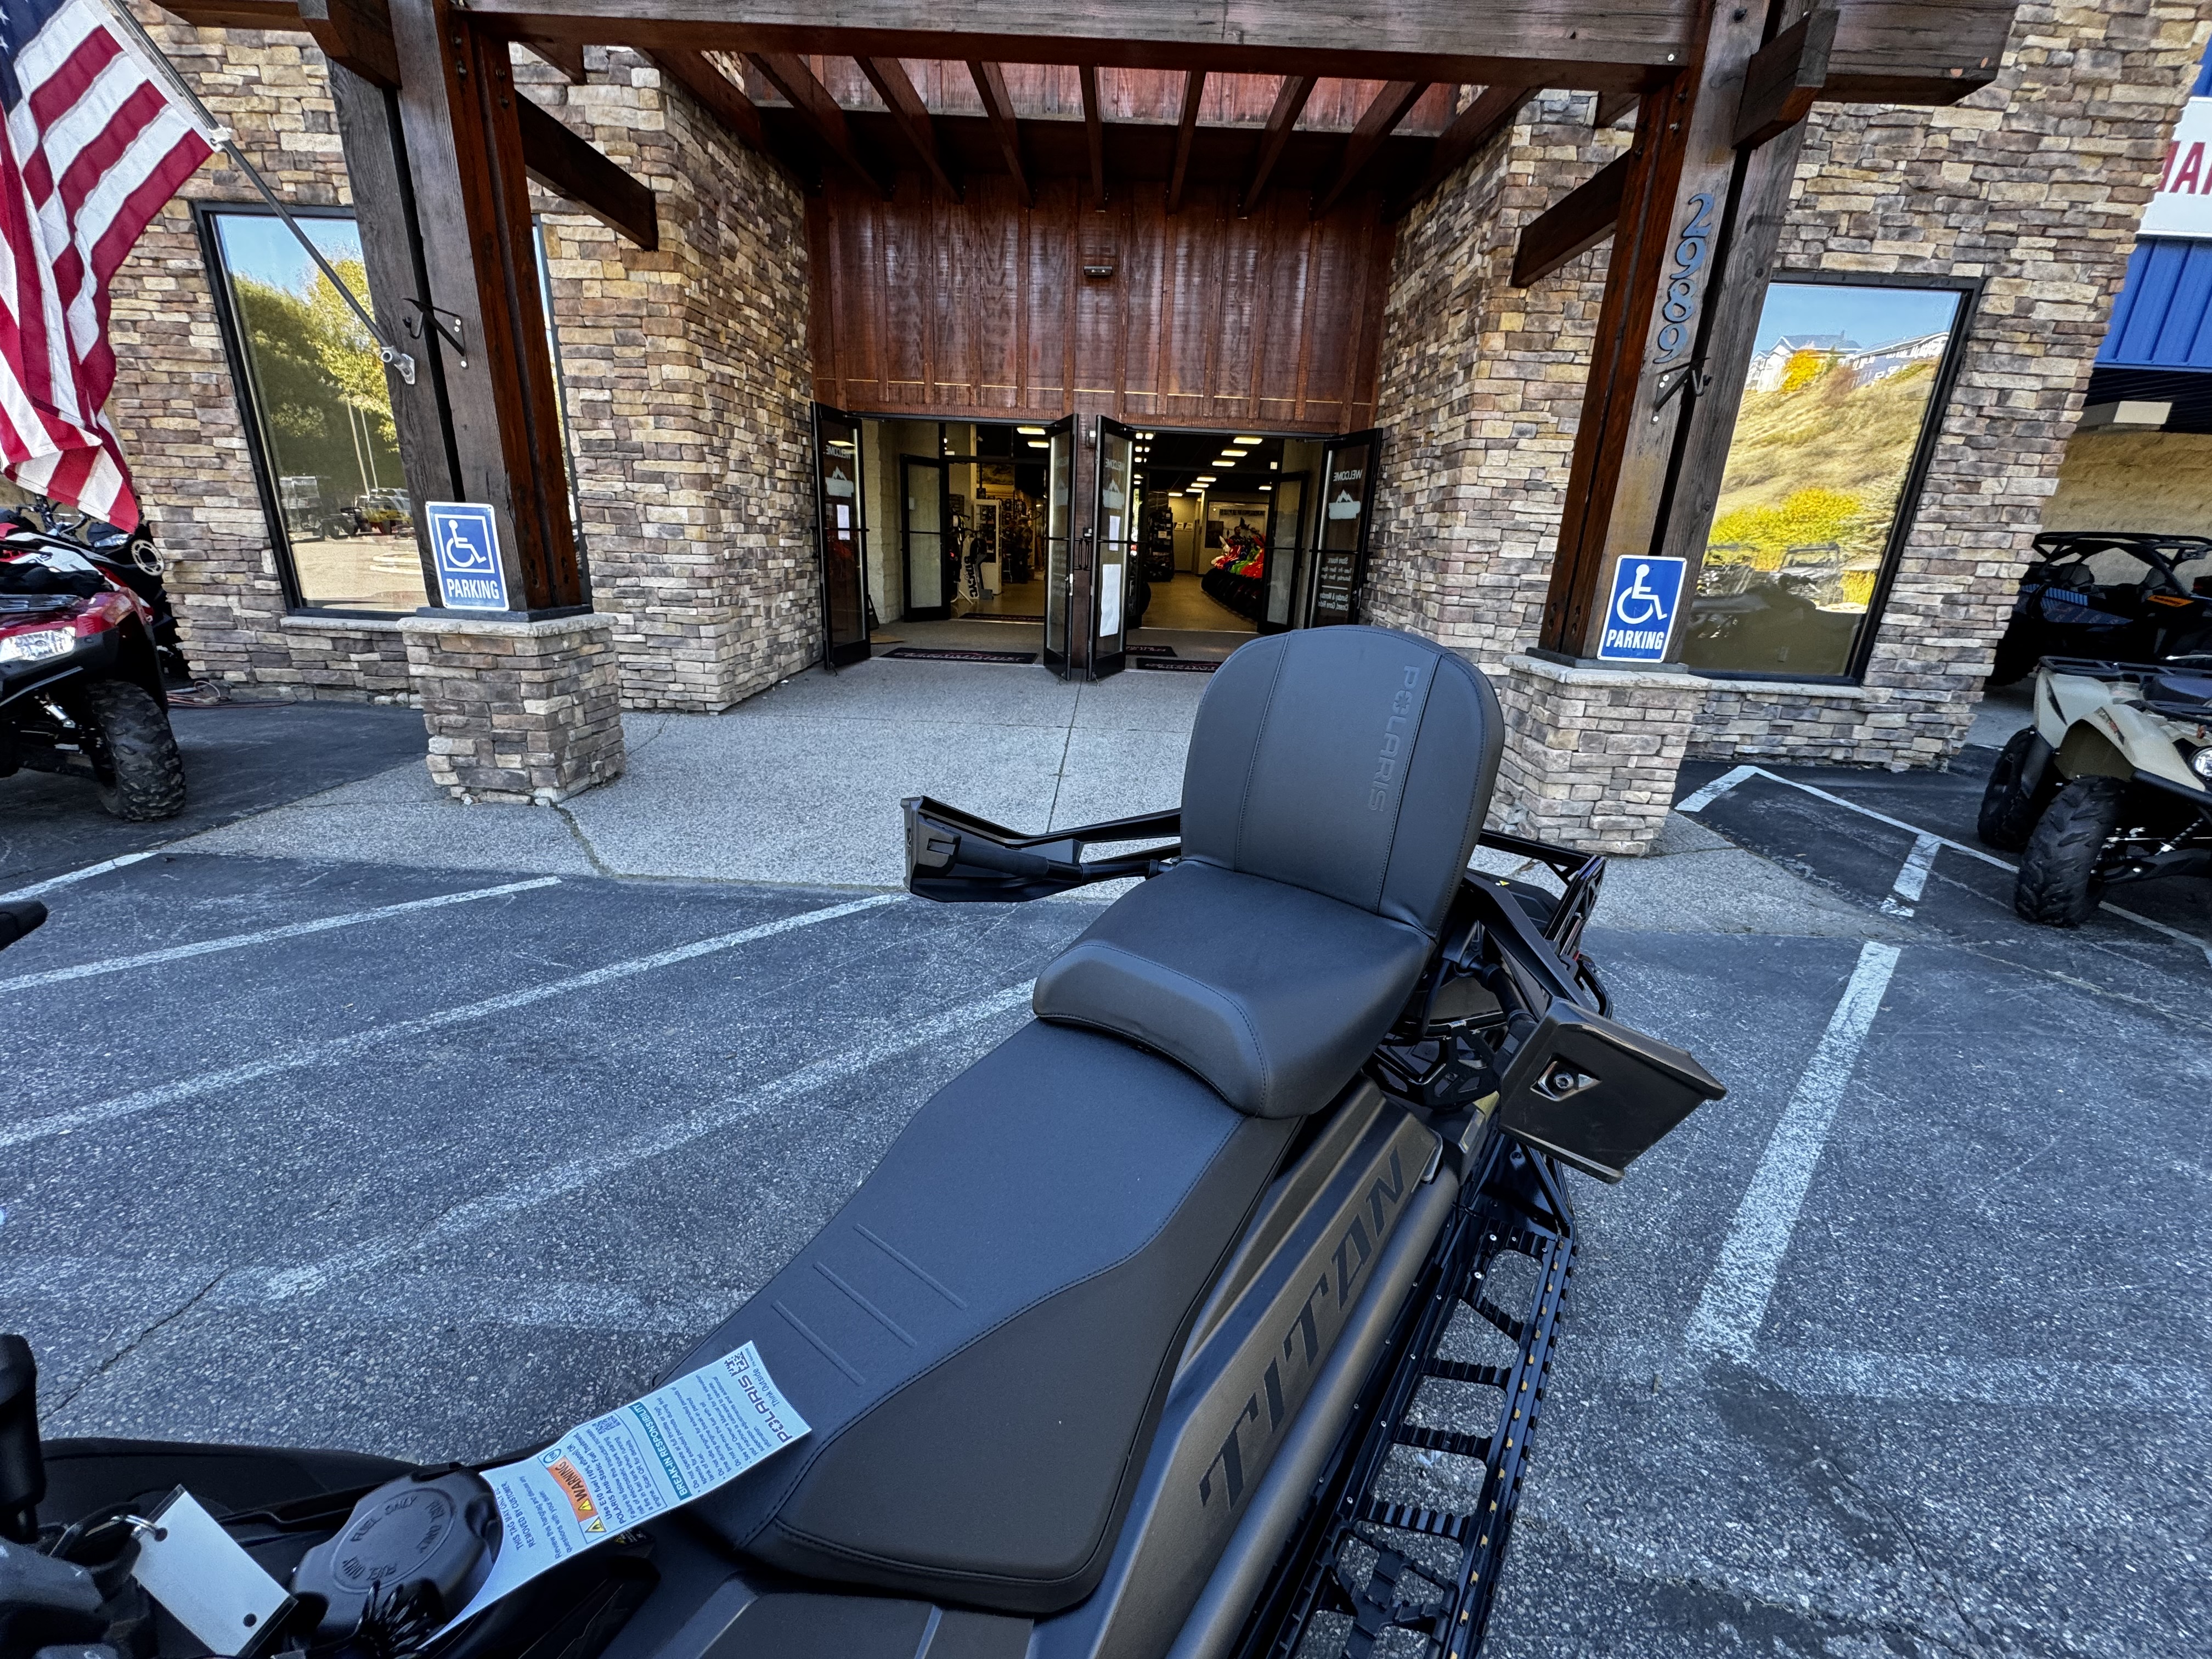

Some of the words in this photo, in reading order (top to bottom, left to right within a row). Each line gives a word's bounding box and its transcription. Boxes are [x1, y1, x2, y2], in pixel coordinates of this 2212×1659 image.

[1652, 193, 1714, 364] 2989
[446, 578, 500, 599] PARKING
[1606, 629, 1664, 650] PARKING
[1368, 665, 1421, 812] POLARIS
[1199, 1146, 1404, 1512] TITAN
[751, 1368, 770, 1392] Outside
[765, 1390, 780, 1407] Think
[737, 1374, 793, 1443] POLARIS
[632, 1403, 668, 1458] RESPONSIBILITY
[586, 1451, 599, 1464] Fuel
[712, 1458, 720, 1468] not
[729, 1450, 737, 1460] not
[733, 1458, 741, 1466] Do
[584, 1464, 597, 1480] (10%
[594, 1462, 613, 1494] Anti-Static
[663, 1456, 688, 1496] BREAK-IN
[687, 1470, 695, 1480] not
[716, 1467, 725, 1476] Do
[554, 1461, 588, 1502] WARNING
[590, 1479, 601, 1493] fuel
[614, 1477, 625, 1494] follow
[634, 1481, 644, 1493] fuel
[641, 1474, 652, 1489] Scan
[692, 1479, 700, 1489] Do
[545, 1500, 557, 1514] your
[596, 1492, 607, 1506] E10
[501, 1509, 512, 1522] MAY
[514, 1508, 523, 1518] BY
[535, 1503, 549, 1527] hangtag
[603, 1505, 613, 1520] Use
[607, 1494, 627, 1525] POLARIS
[624, 1499, 637, 1519] Failure
[550, 1512, 561, 1526] with
[506, 1521, 518, 1536] TAG
[517, 1516, 535, 1548] REMOVED
[544, 1525, 554, 1537] this
[512, 1534, 524, 1550] THIS
[556, 1524, 573, 1553] questions
[549, 1536, 563, 1559] Review
